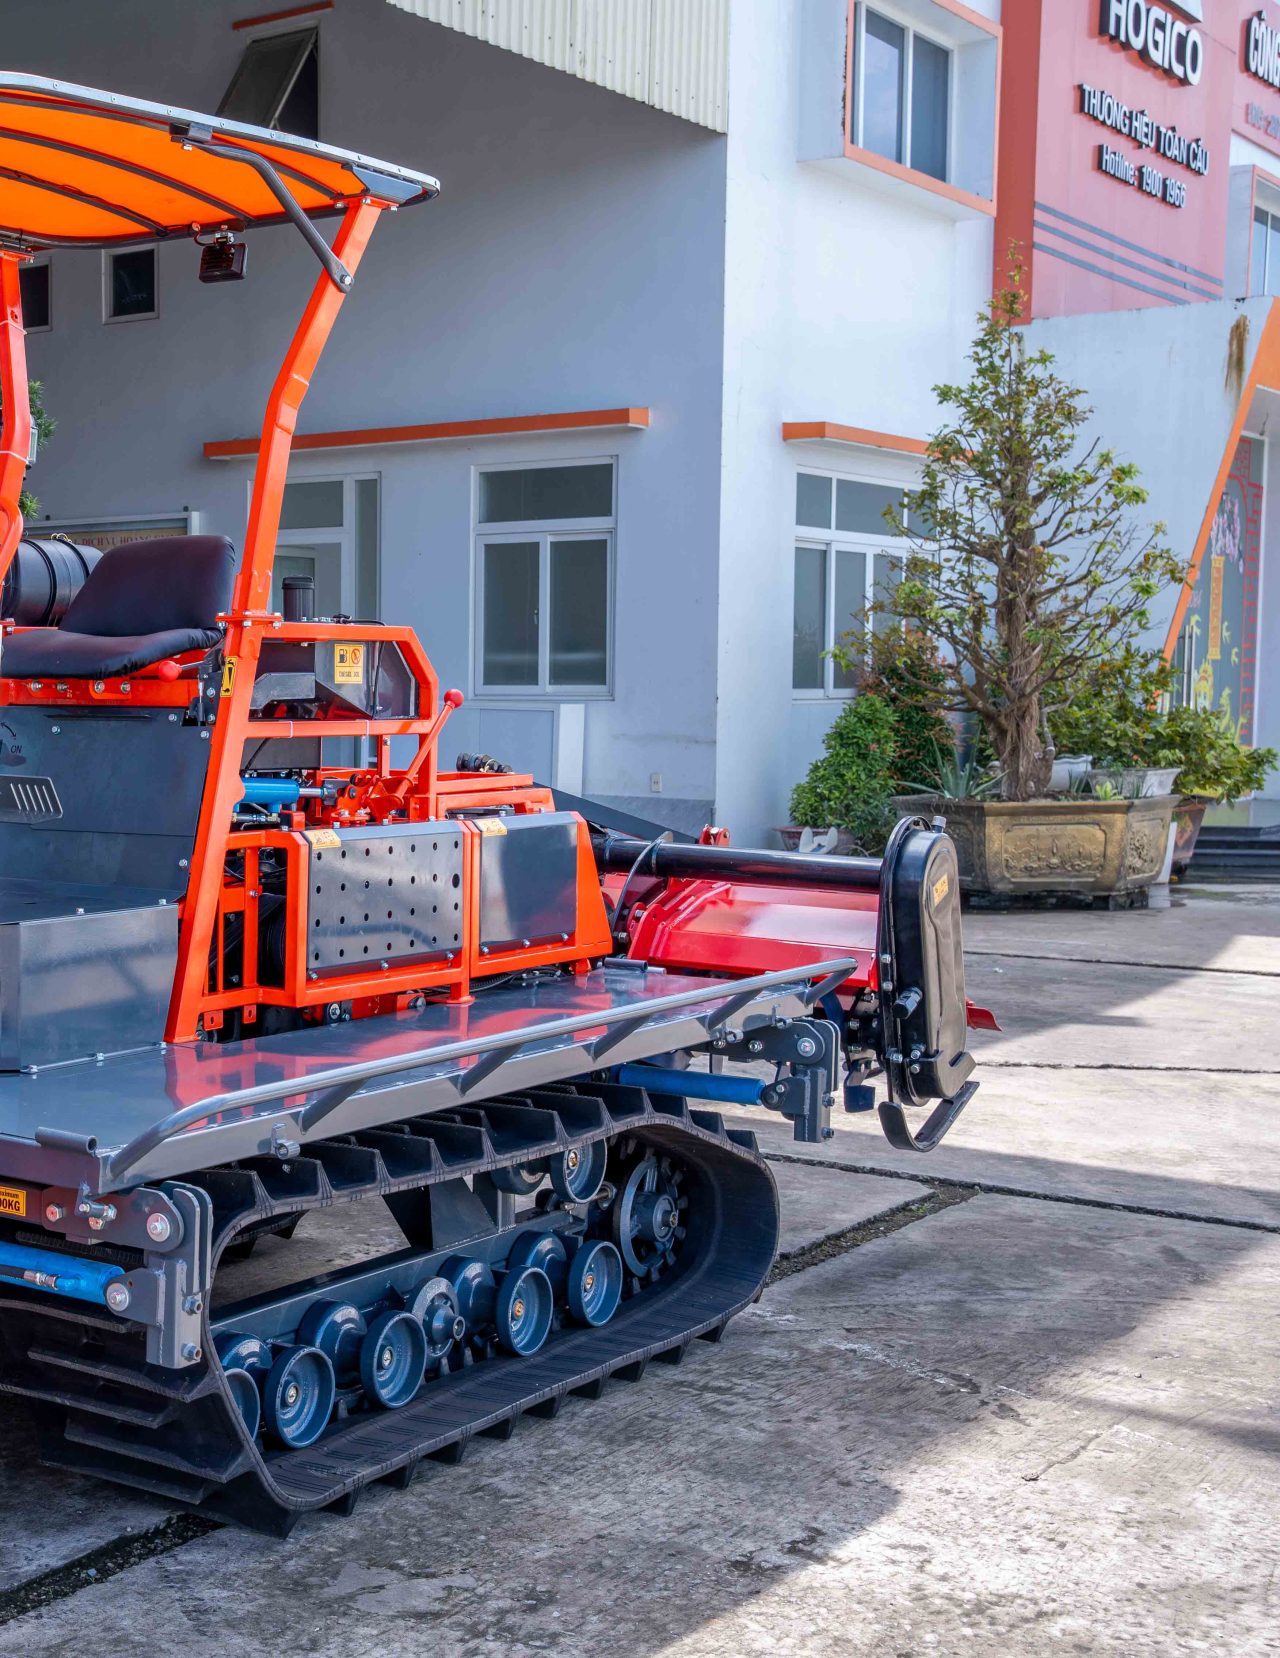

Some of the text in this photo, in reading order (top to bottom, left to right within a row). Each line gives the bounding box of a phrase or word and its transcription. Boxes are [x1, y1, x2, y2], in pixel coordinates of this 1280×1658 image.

[1108, 0, 1204, 86] HOGICO
[1101, 144, 1187, 209] Hotline: 1900 1966
